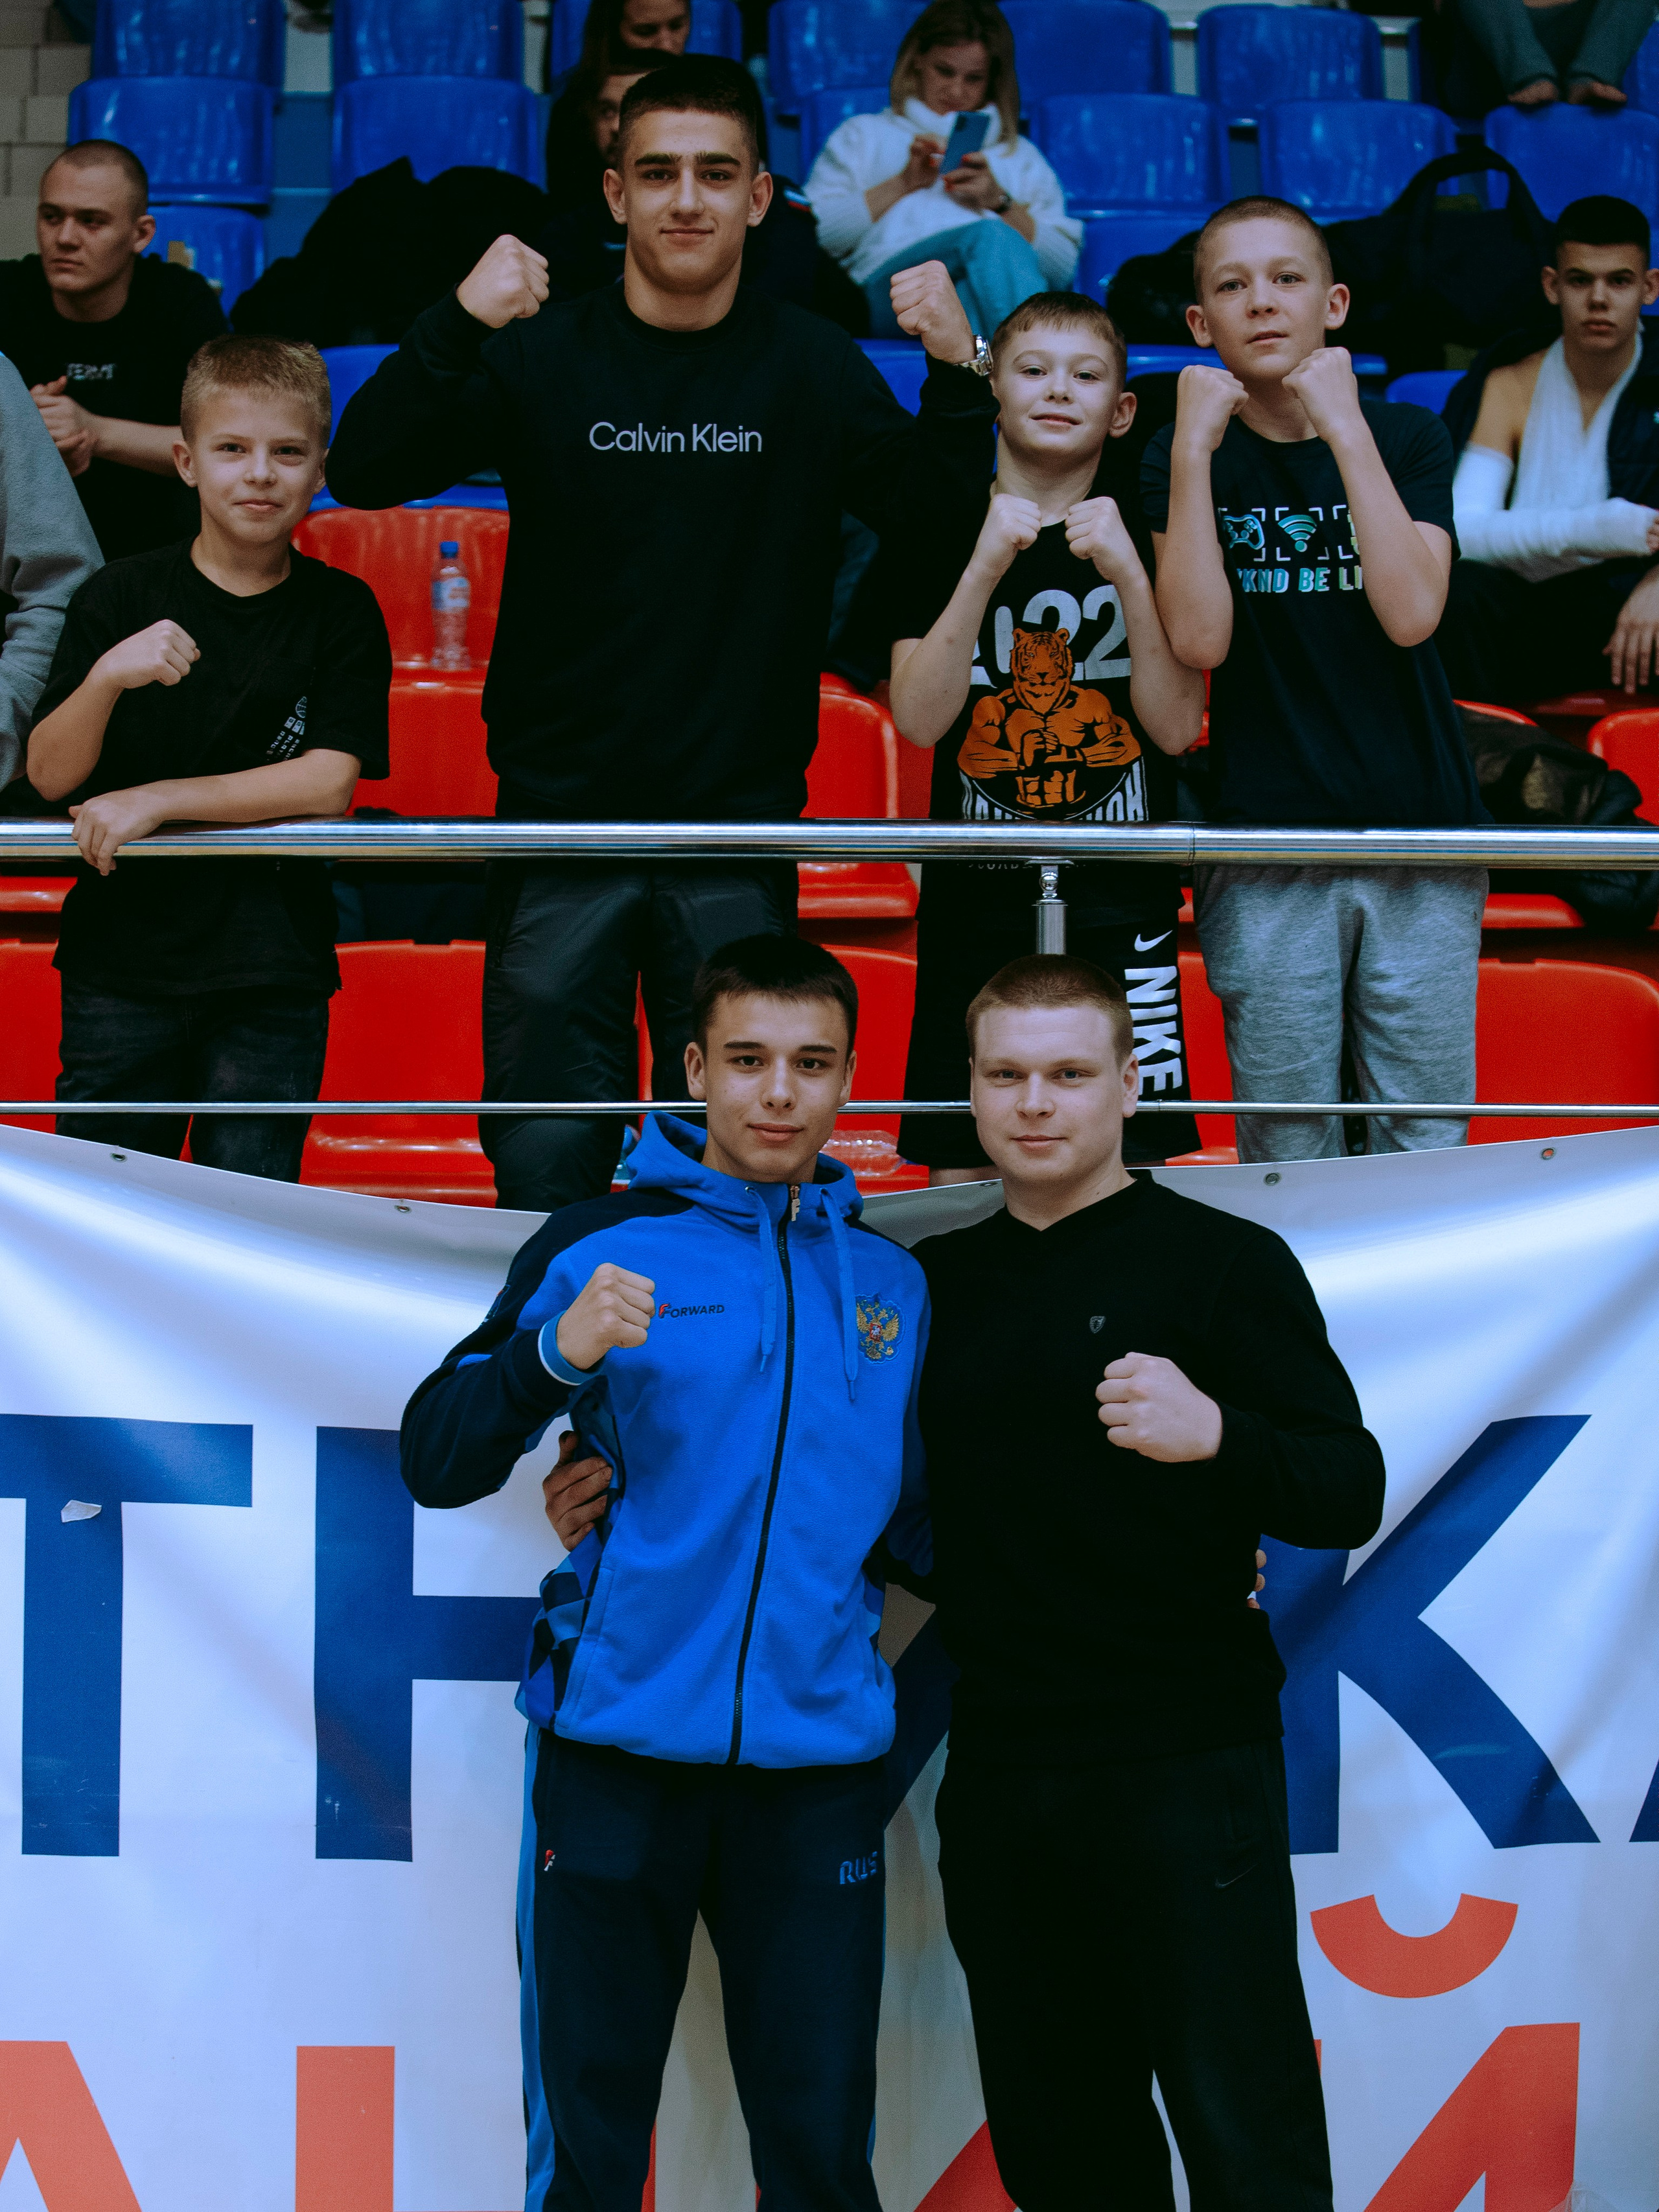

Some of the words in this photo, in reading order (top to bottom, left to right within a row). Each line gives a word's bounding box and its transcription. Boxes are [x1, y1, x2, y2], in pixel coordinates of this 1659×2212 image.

[589, 421, 685, 452] Calvin
[692, 423, 763, 452] Klein
[1236, 568, 1290, 593] KND
[1298, 567, 1331, 592] BE
[1124, 965, 1183, 1096] NIKE
[658, 1302, 725, 1319] FORWARD
[839, 1850, 878, 1885] RUS
